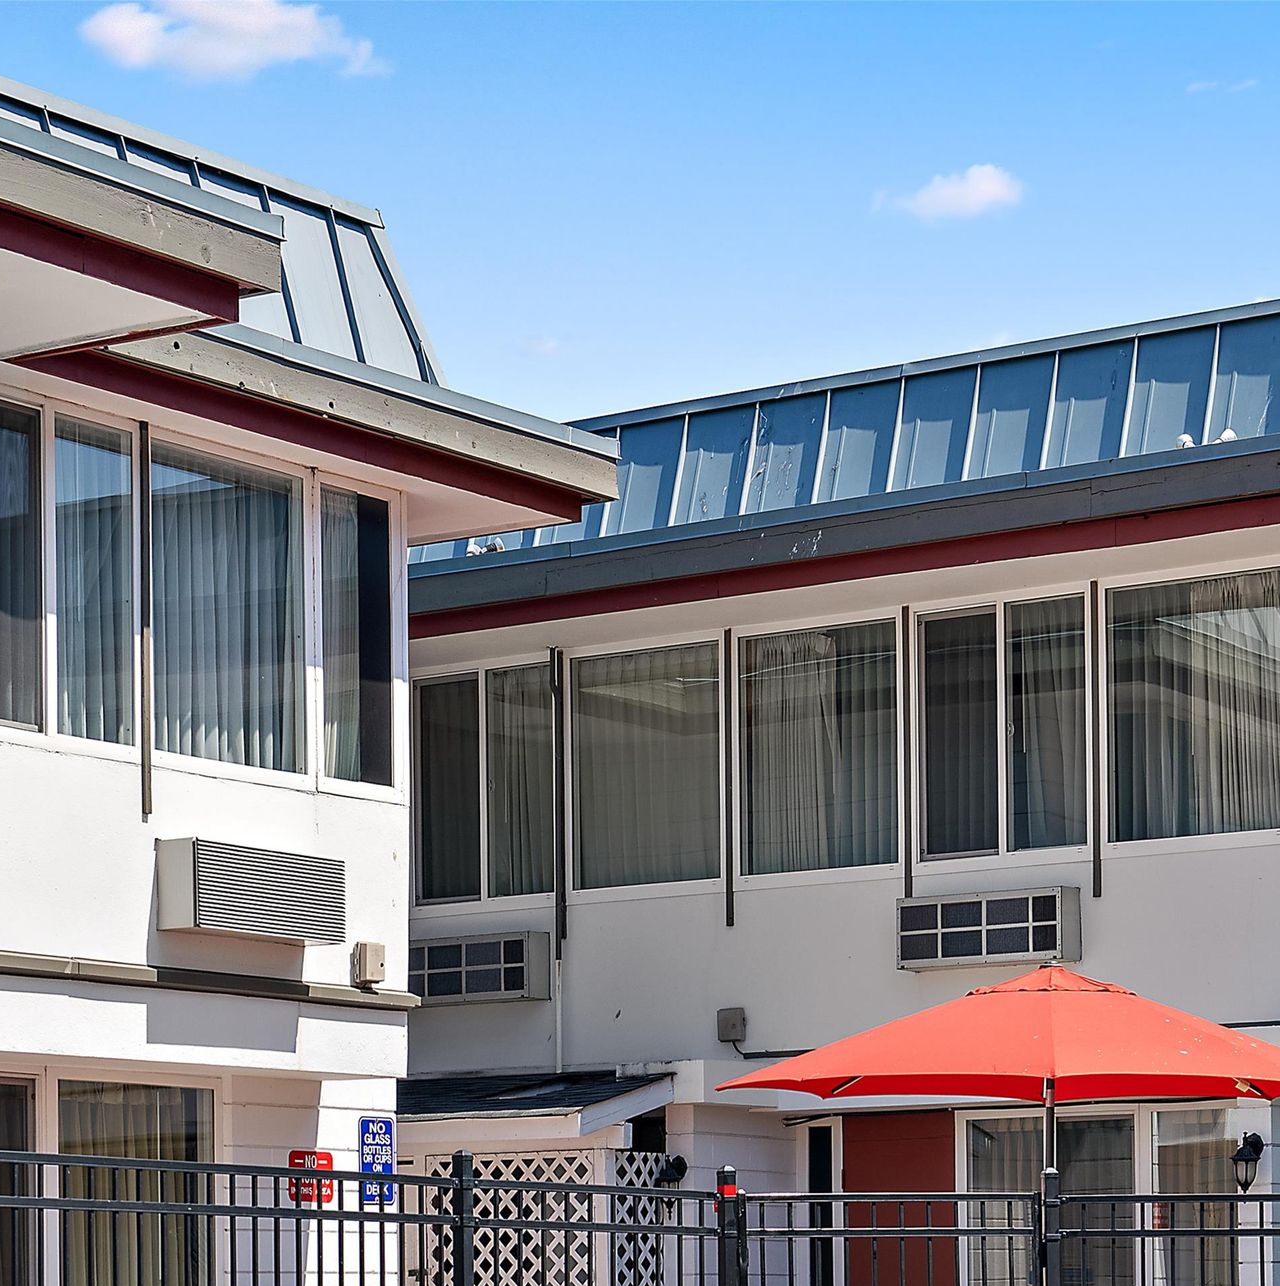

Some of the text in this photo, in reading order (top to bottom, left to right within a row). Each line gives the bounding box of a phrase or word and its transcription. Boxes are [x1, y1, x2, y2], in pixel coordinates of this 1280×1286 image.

[369, 1122, 386, 1134] NO
[364, 1134, 391, 1145] GLASS
[363, 1145, 392, 1154] BOTTLES
[305, 1155, 317, 1168] NO
[363, 1155, 392, 1164] OR CUPS
[372, 1164, 383, 1173] ON
